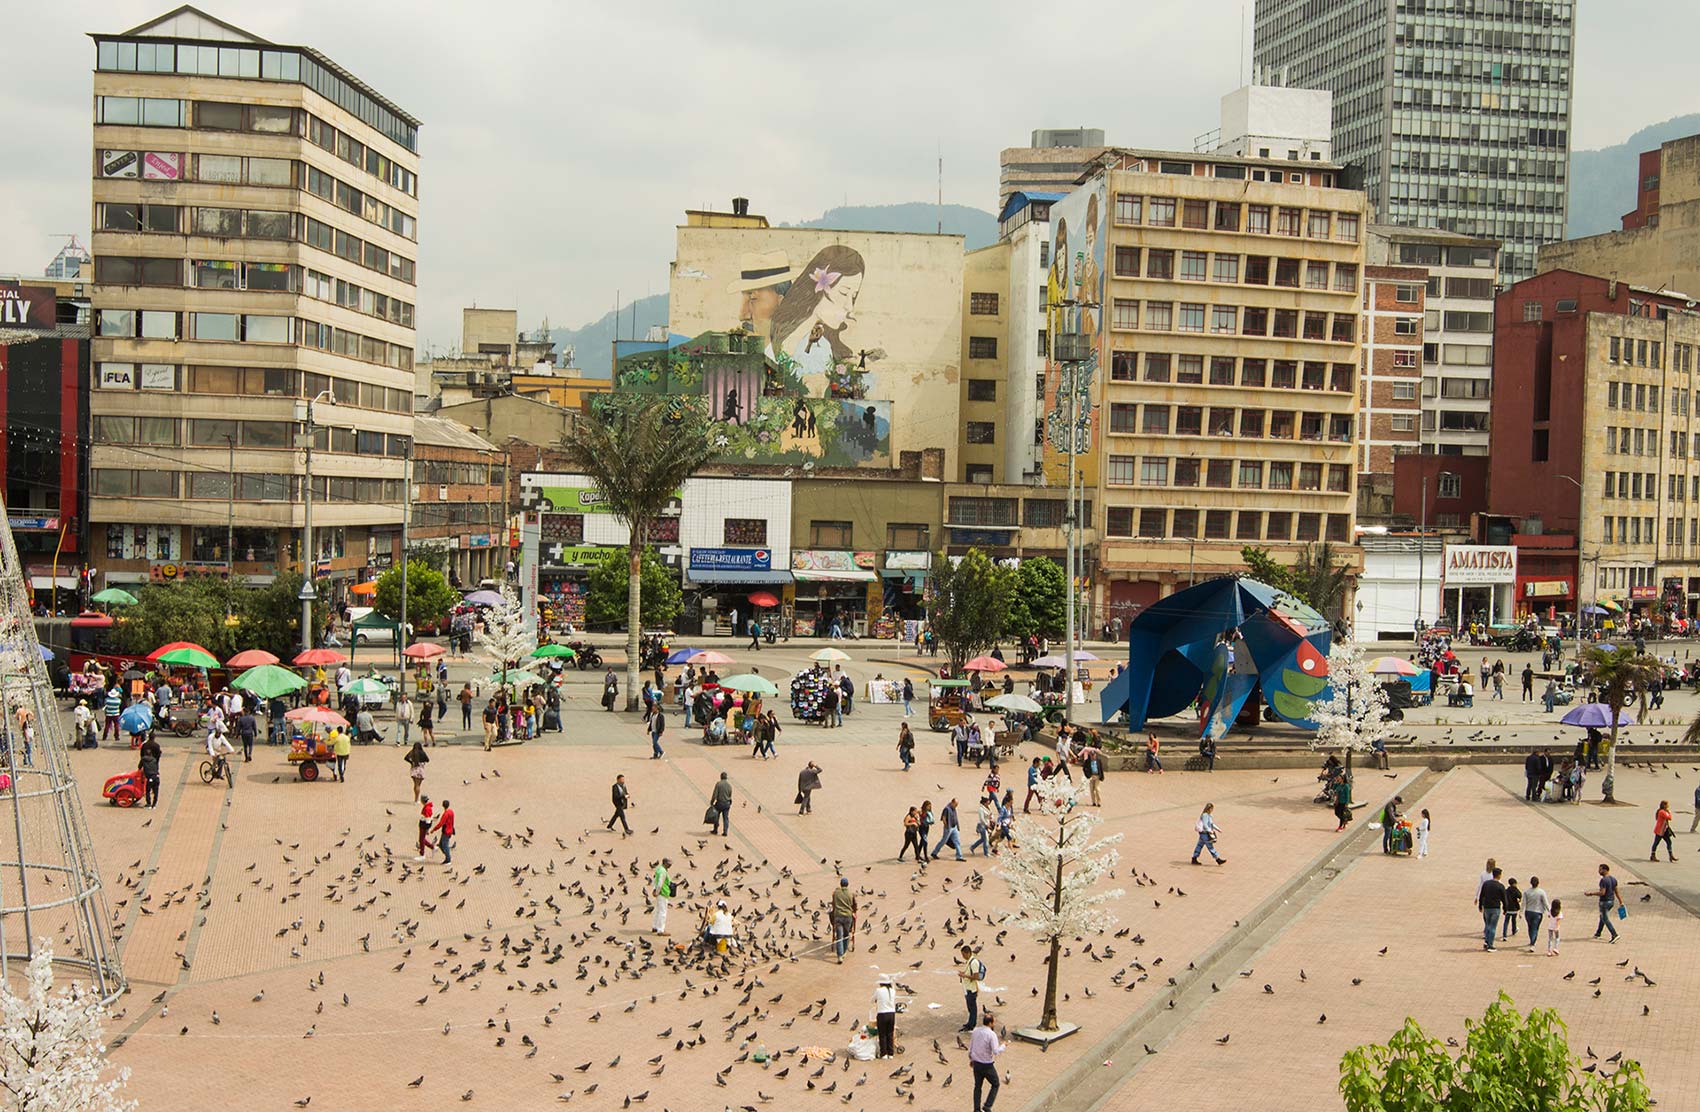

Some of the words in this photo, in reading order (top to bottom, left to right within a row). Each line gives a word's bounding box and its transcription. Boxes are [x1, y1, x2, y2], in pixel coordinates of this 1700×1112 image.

[571, 550, 578, 562] y
[580, 548, 611, 561] mucho
[1449, 551, 1514, 569] AMATISTA
